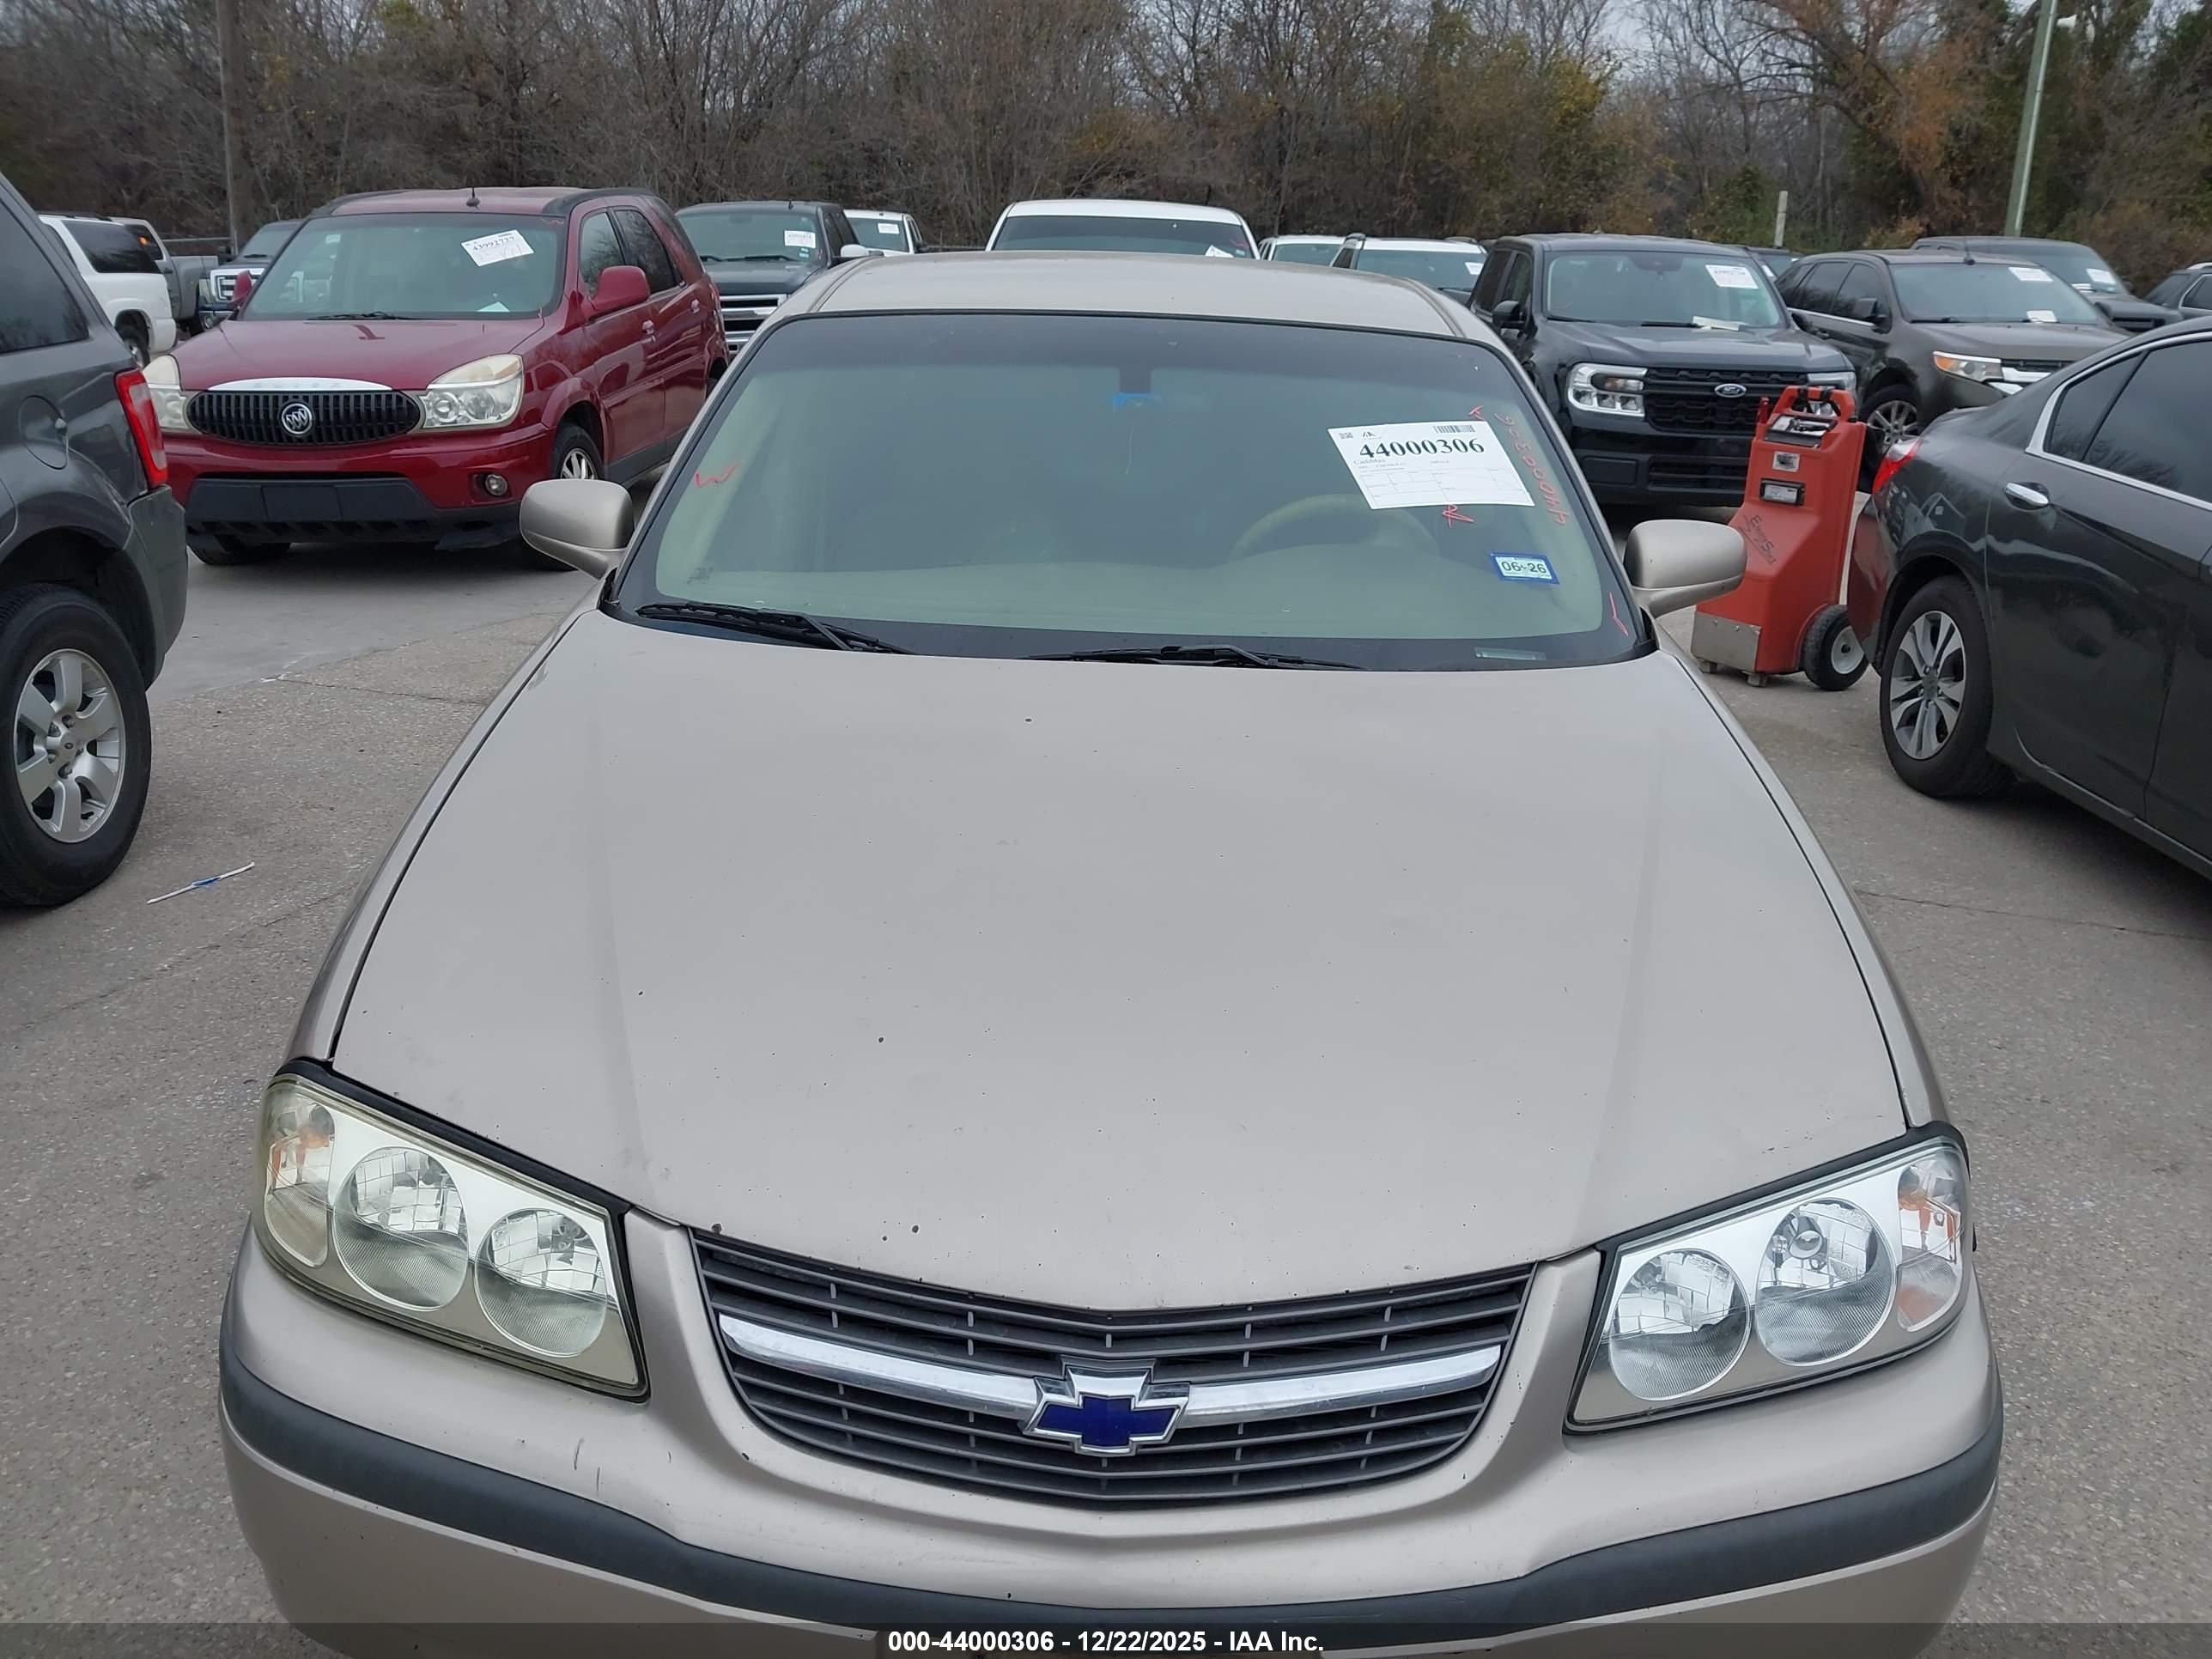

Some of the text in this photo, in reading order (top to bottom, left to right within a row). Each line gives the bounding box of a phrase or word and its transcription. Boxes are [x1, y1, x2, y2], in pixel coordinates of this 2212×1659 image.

[1359, 438, 1485, 458] 44000306
[1501, 561, 1547, 574] 06 26
